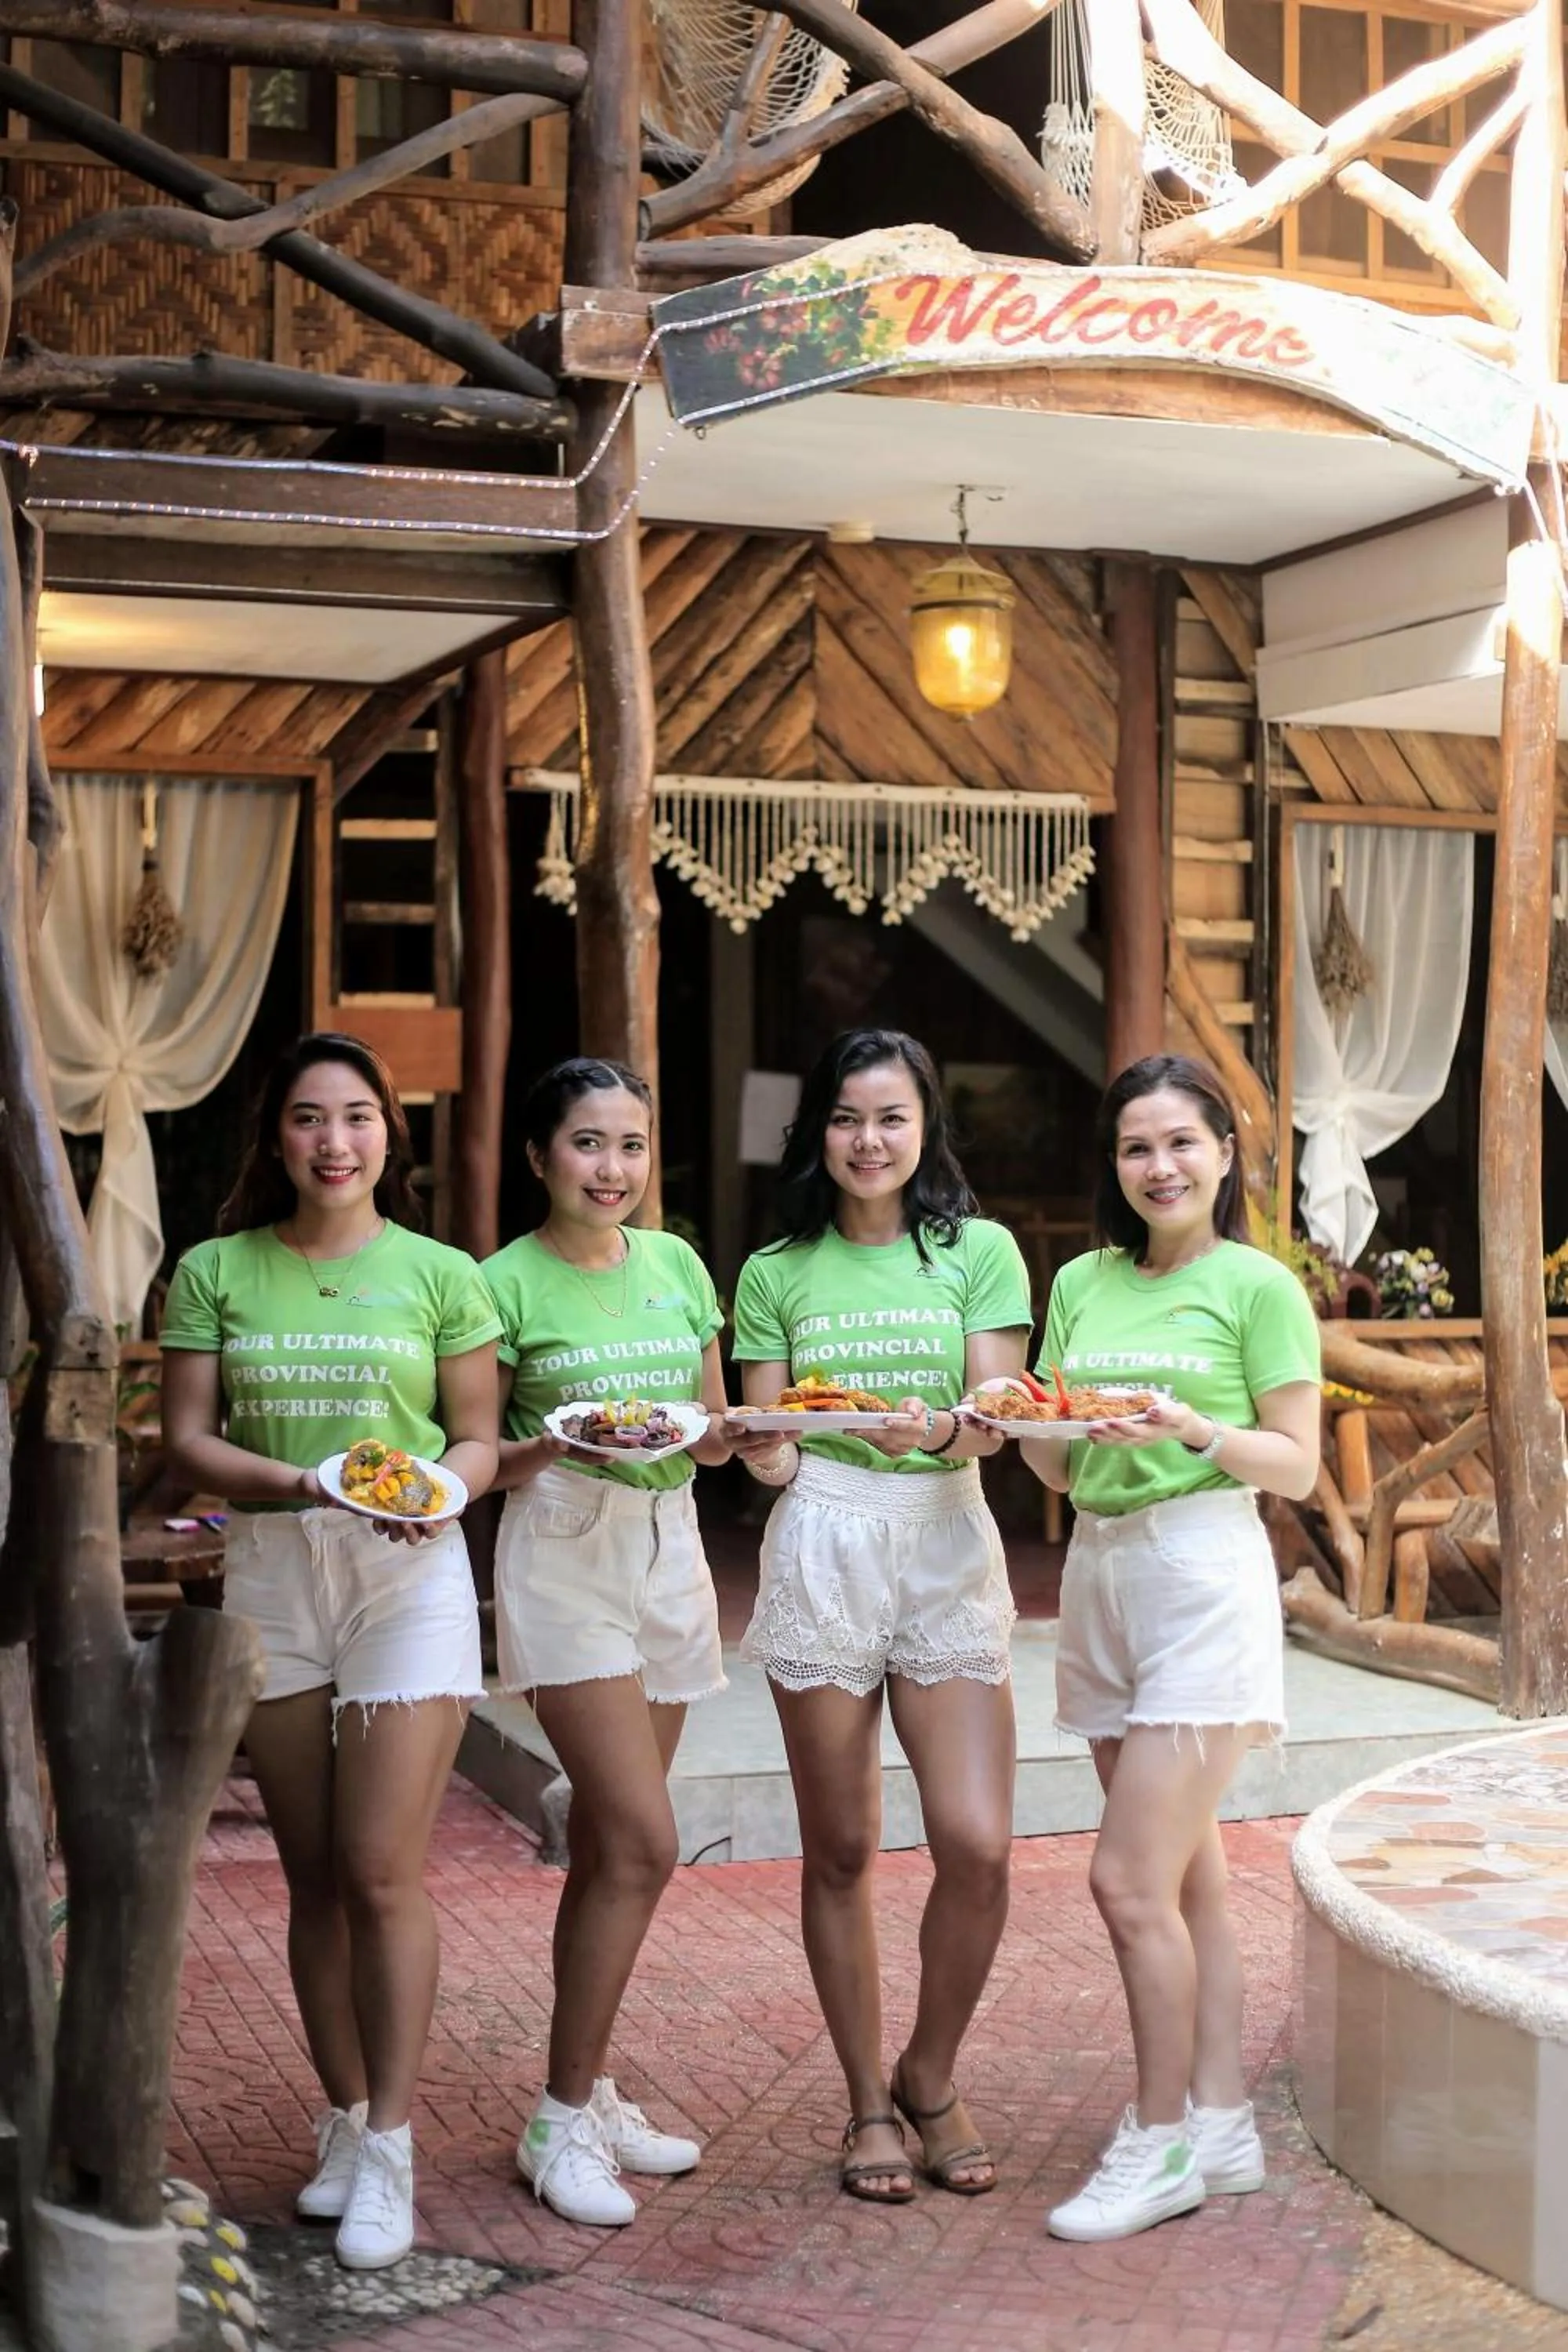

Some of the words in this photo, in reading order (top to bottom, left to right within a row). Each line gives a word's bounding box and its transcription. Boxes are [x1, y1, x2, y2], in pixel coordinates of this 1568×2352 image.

[895, 272, 1315, 367] Welcome
[223, 1334, 274, 1353] OUR
[283, 1334, 420, 1359] ULTIMATE
[531, 1347, 599, 1375] YOUR
[602, 1337, 702, 1359] ULTIMAT
[795, 1338, 947, 1368] PROVINCIAL
[232, 1365, 391, 1384] PROVINCIAL
[1086, 1352, 1213, 1374] ULTIMATE
[833, 1370, 948, 1390] ERIENCE!
[234, 1399, 390, 1418] EXPERIENCE!
